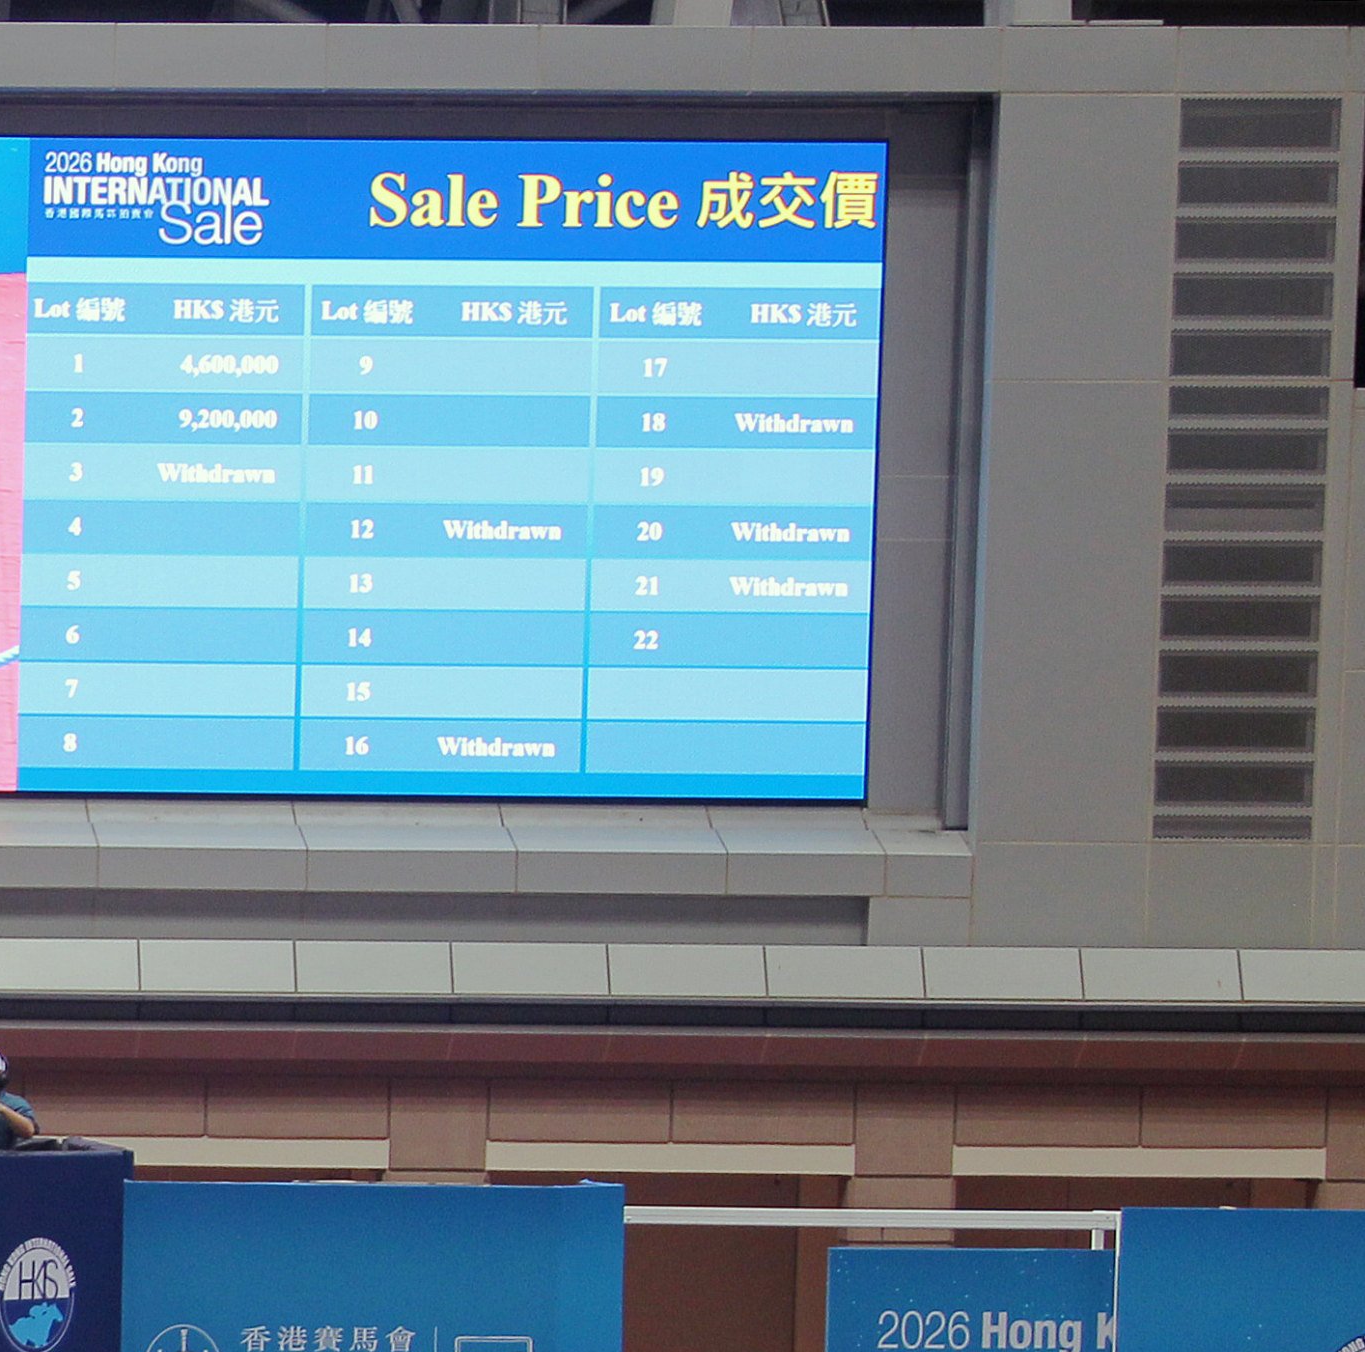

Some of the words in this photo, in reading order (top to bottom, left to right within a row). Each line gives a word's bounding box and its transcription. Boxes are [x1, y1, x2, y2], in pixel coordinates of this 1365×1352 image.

[45, 151, 92, 172] 2026
[96, 152, 148, 177] Hong
[152, 152, 203, 177] Kong
[43, 176, 270, 206] INTERNATIONAL
[370, 172, 498, 227] Sale
[517, 174, 680, 228] Price
[697, 171, 879, 228] 成交價
[159, 200, 263, 245] Sale
[34, 298, 71, 318] Lot
[229, 299, 279, 322] 港元
[322, 301, 358, 320] Lot
[518, 301, 567, 325] 港元
[610, 303, 647, 322] Lot
[807, 303, 857, 326] 港元
[75, 354, 82, 372] 1
[180, 355, 279, 377] 4,600,000
[360, 356, 373, 374] 9
[645, 358, 667, 377] 17
[72, 408, 83, 427] 2
[179, 409, 278, 431] 9,200,000
[355, 411, 378, 429] 10
[643, 413, 666, 432] 18
[735, 413, 854, 433] Withdrawn
[70, 463, 83, 481] 3
[157, 463, 275, 483] Withdrawn
[354, 465, 373, 484] 11
[641, 467, 665, 486] 19
[69, 517, 81, 535] 4
[352, 519, 374, 538] 12
[443, 520, 562, 540] Withdrawn
[637, 522, 663, 541] 20
[731, 522, 850, 542] Withdrawn
[67, 571, 80, 590] 5
[350, 574, 373, 593] 13
[636, 576, 658, 595] 21
[730, 577, 848, 596] Withdrawn
[66, 625, 80, 643] 6
[349, 628, 372, 647] 14
[634, 630, 658, 649] 22
[66, 679, 78, 697] 7
[347, 682, 371, 701] 15
[64, 733, 77, 752] 8
[346, 736, 369, 755] 16
[438, 737, 555, 757] Withdrawn
[877, 1310, 970, 1349] 2026
